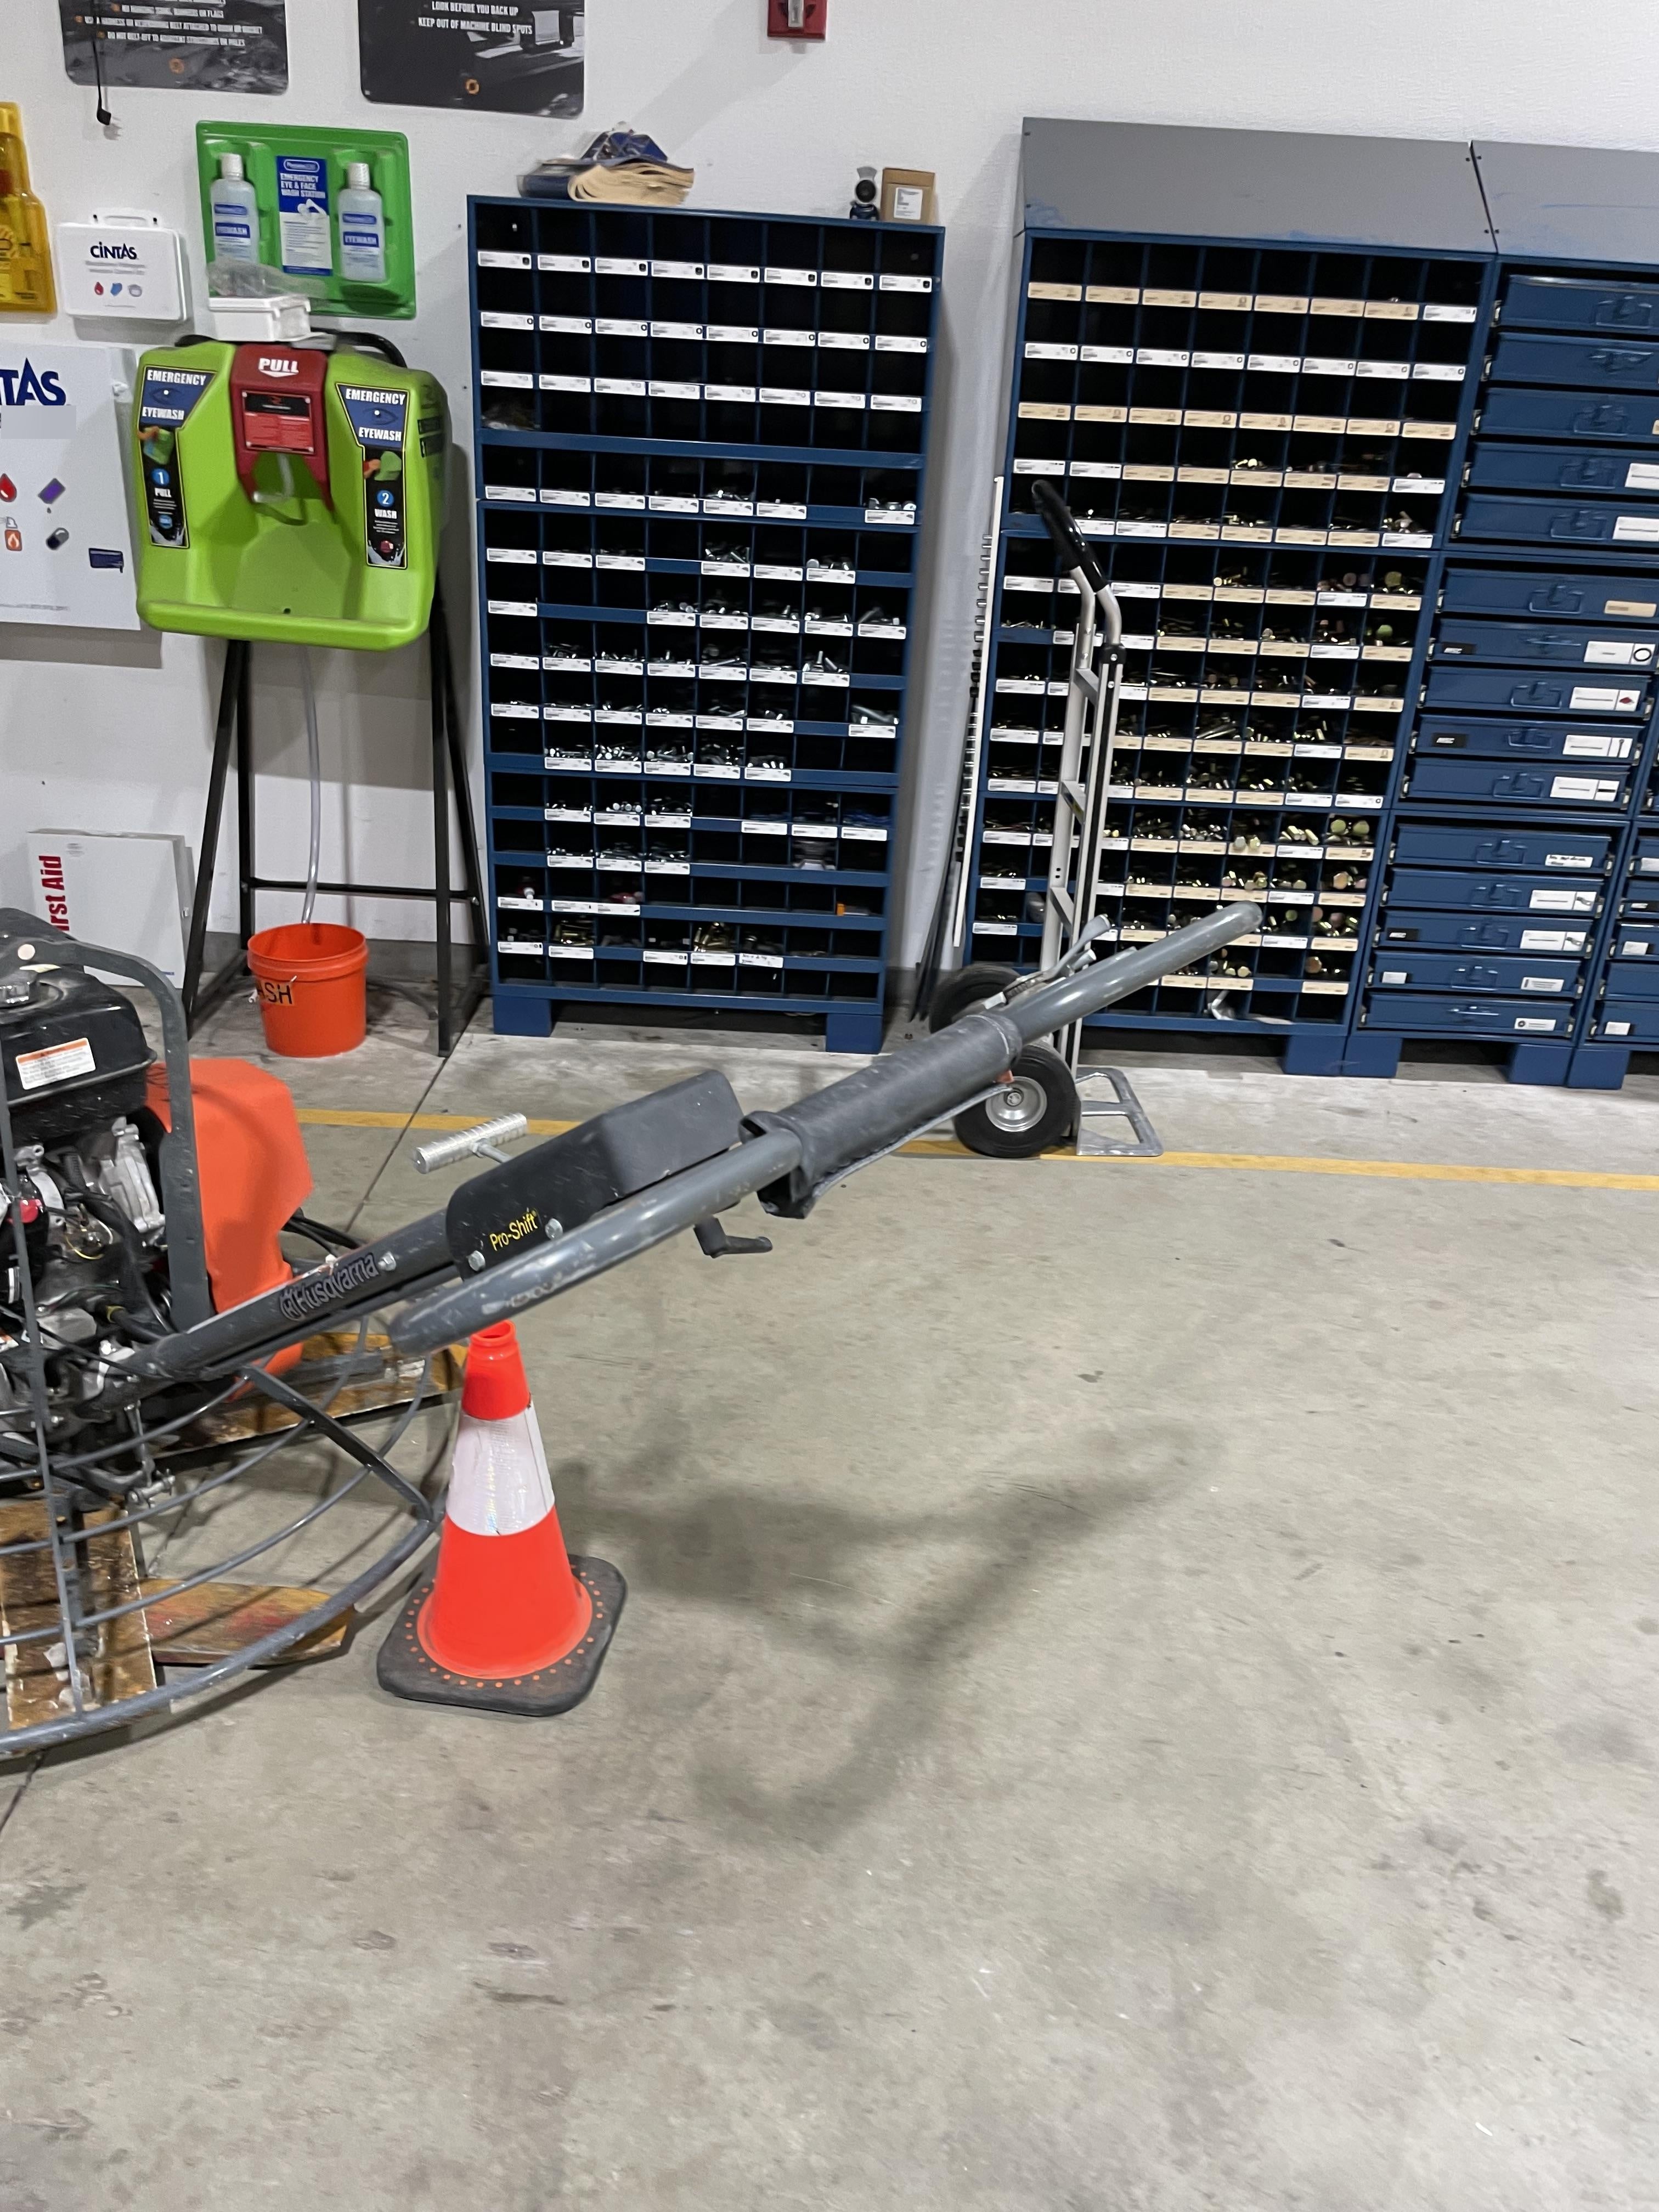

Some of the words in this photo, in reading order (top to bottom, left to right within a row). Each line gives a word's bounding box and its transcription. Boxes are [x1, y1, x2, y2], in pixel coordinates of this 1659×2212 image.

[432, 1, 449, 10] LOOK
[450, 2, 476, 13] BEFORE
[476, 4, 490, 14] YOU
[490, 5, 509, 15] BACK
[509, 7, 519, 16] UP
[418, 17, 436, 27] KEEP
[436, 19, 449, 29] OUT
[450, 19, 459, 29] OF
[460, 20, 490, 32] MACHINE
[491, 22, 511, 33] BLIND
[512, 24, 533, 35] SPOTS
[90, 241, 138, 261] CINTAS
[258, 357, 300, 374] PULL
[0, 357, 66, 406] TAS
[146, 369, 207, 386] EMERGENCY
[346, 388, 406, 405] EMERGENCY
[142, 406, 185, 421] EYEWASH
[358, 427, 402, 442] EYEWASH
[157, 471, 164, 484] 1
[382, 492, 390, 505] 2
[374, 508, 398, 520] WASH
[38, 855, 65, 891] Aid
[44, 895, 70, 932] irst
[292, 1252, 380, 1313] Husqvarna
